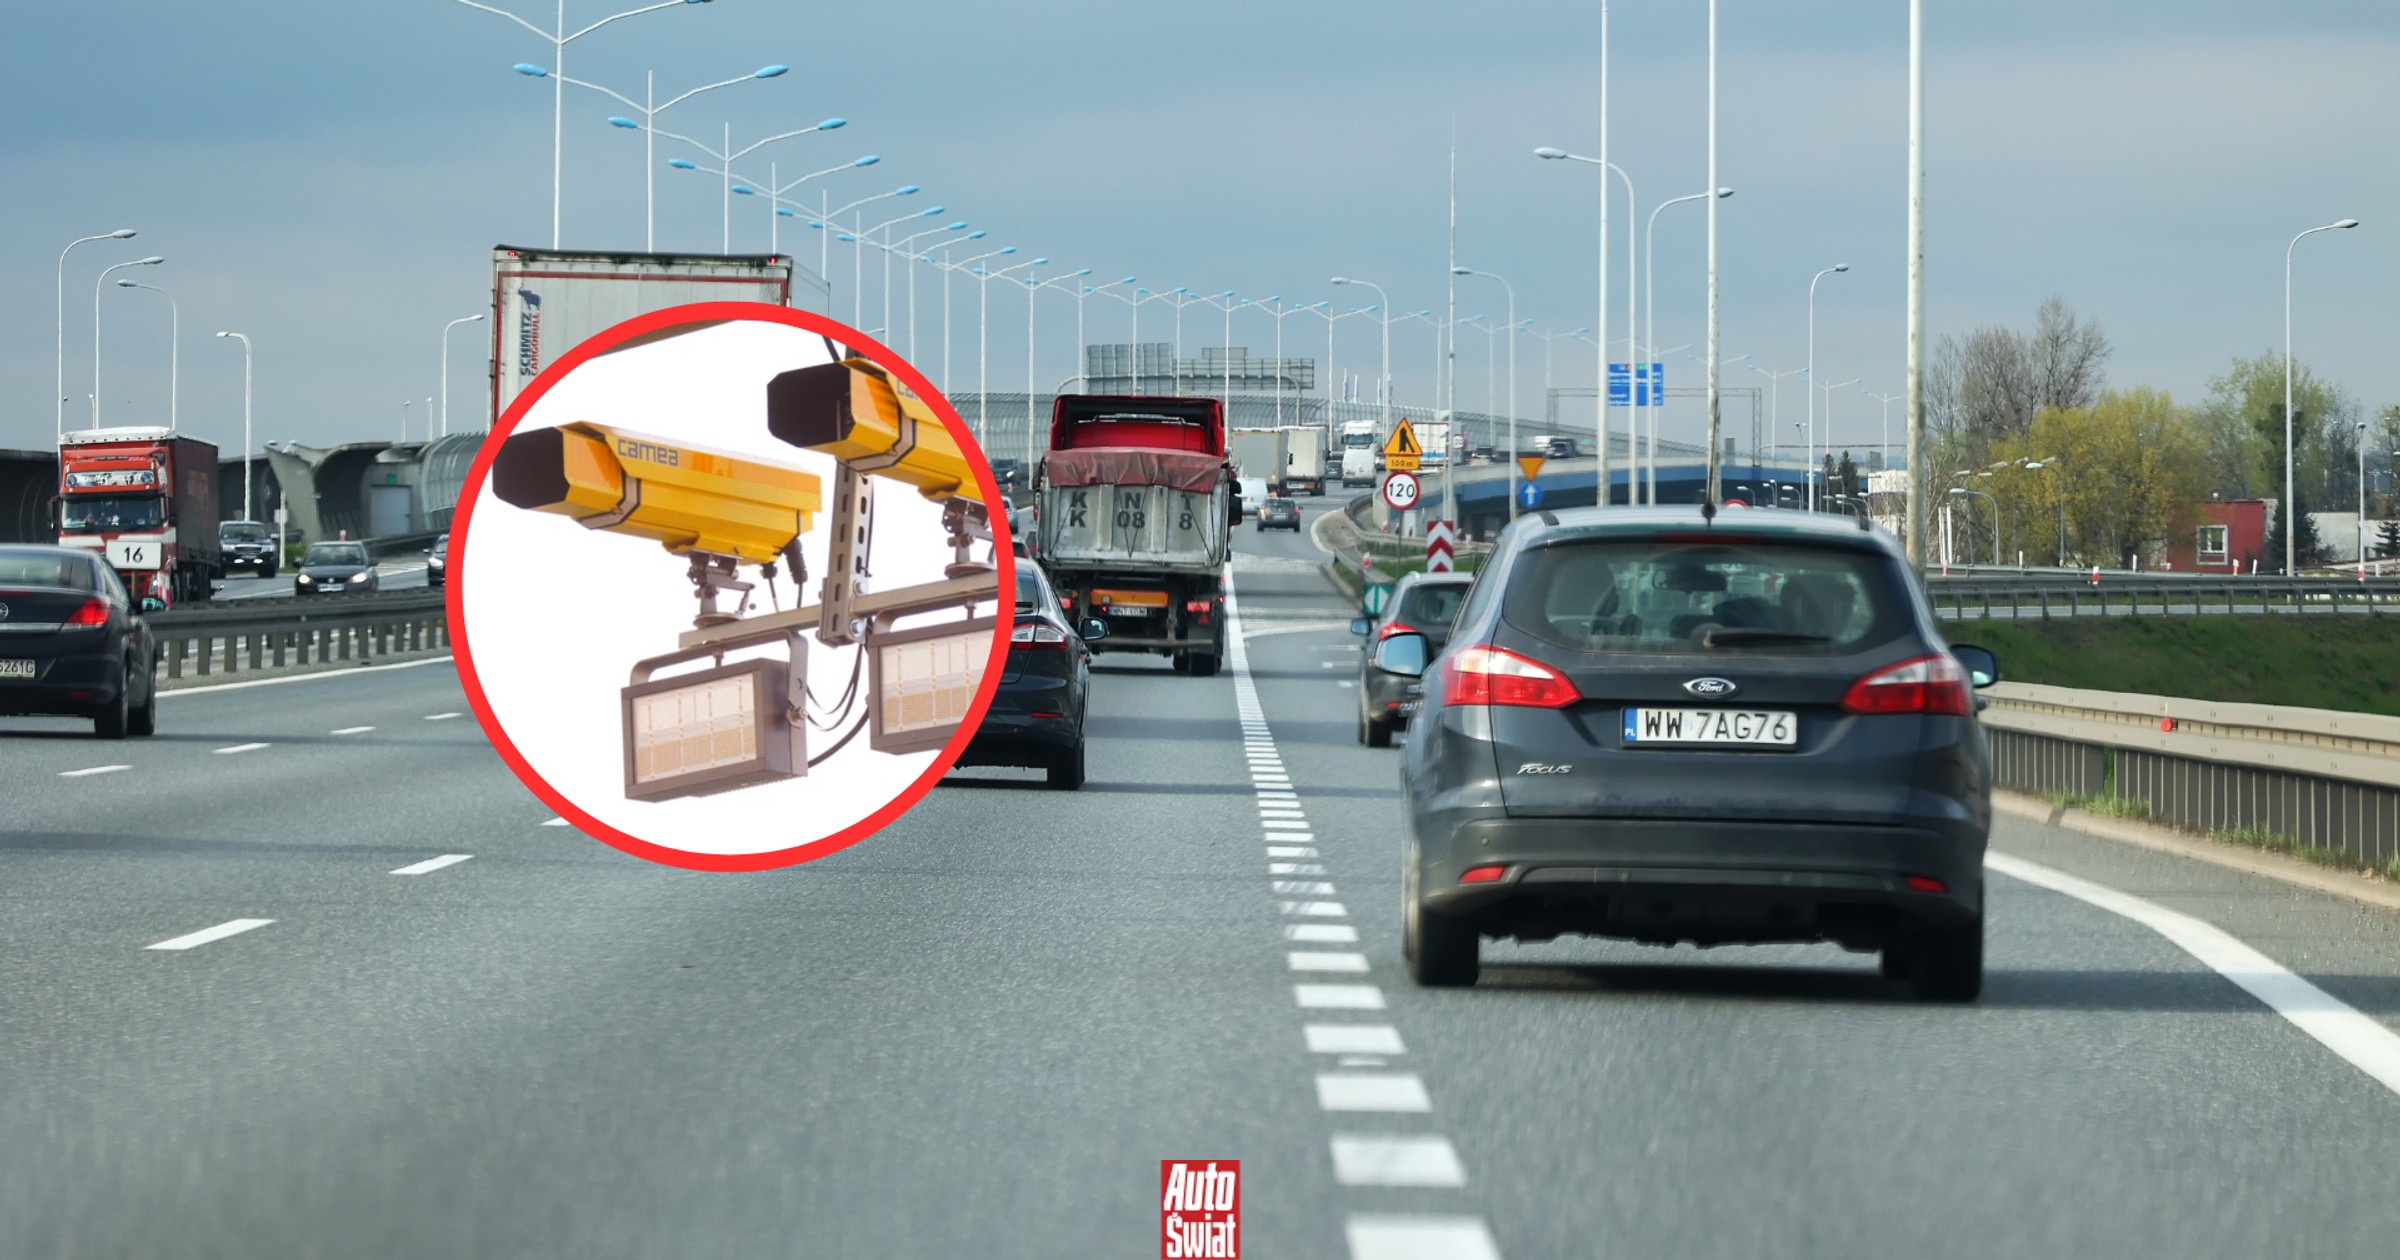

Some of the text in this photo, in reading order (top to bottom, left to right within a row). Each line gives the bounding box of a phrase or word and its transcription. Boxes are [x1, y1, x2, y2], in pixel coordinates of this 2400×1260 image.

[520, 312, 532, 376] SCHMITZ
[531, 312, 540, 376] CARGOBULL
[618, 439, 679, 467] camea
[1389, 482, 1415, 498] 120
[1070, 491, 1088, 509] K
[1124, 492, 1142, 510] N
[1070, 510, 1193, 530] K 08 8
[123, 547, 144, 564] 16
[1697, 681, 1725, 693] Ford
[1624, 727, 1636, 737] PL
[1645, 710, 1788, 741] WW 7AG76
